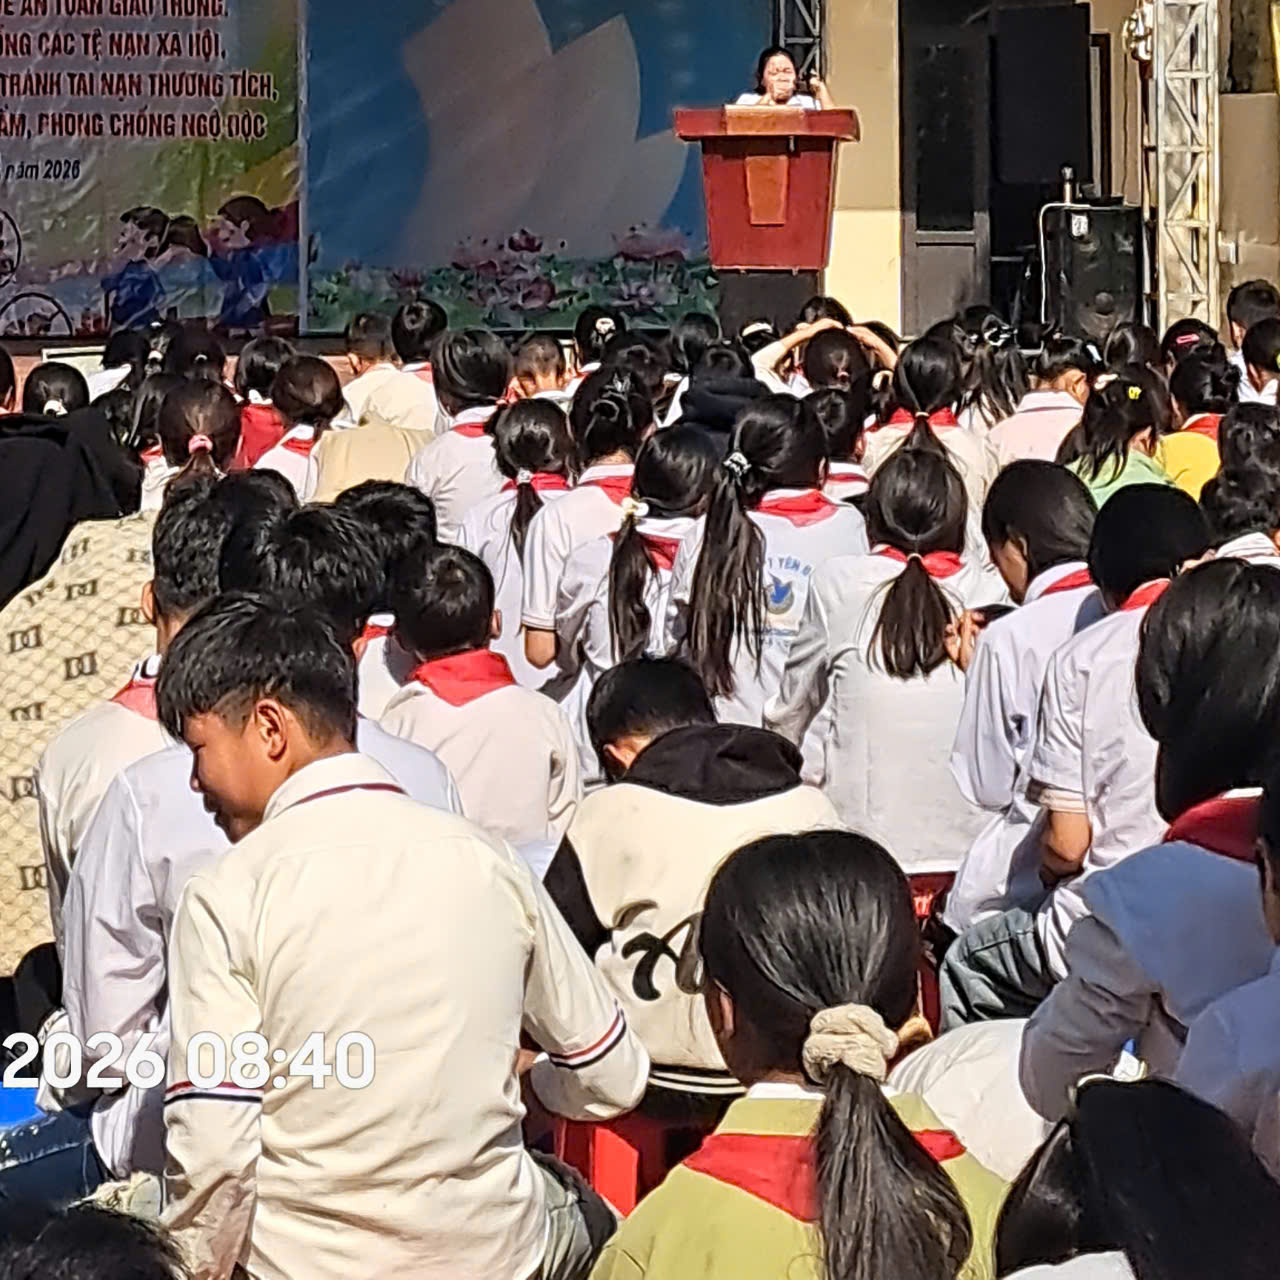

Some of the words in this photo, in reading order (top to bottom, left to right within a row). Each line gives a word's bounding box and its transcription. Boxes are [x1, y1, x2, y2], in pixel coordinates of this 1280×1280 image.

[37, 28, 75, 56] CÁC
[108, 31, 150, 60] NẠN
[67, 72, 94, 97] TAI
[100, 72, 142, 102] NẠN
[229, 70, 279, 102] TÍCH,
[43, 158, 81, 180] 2026
